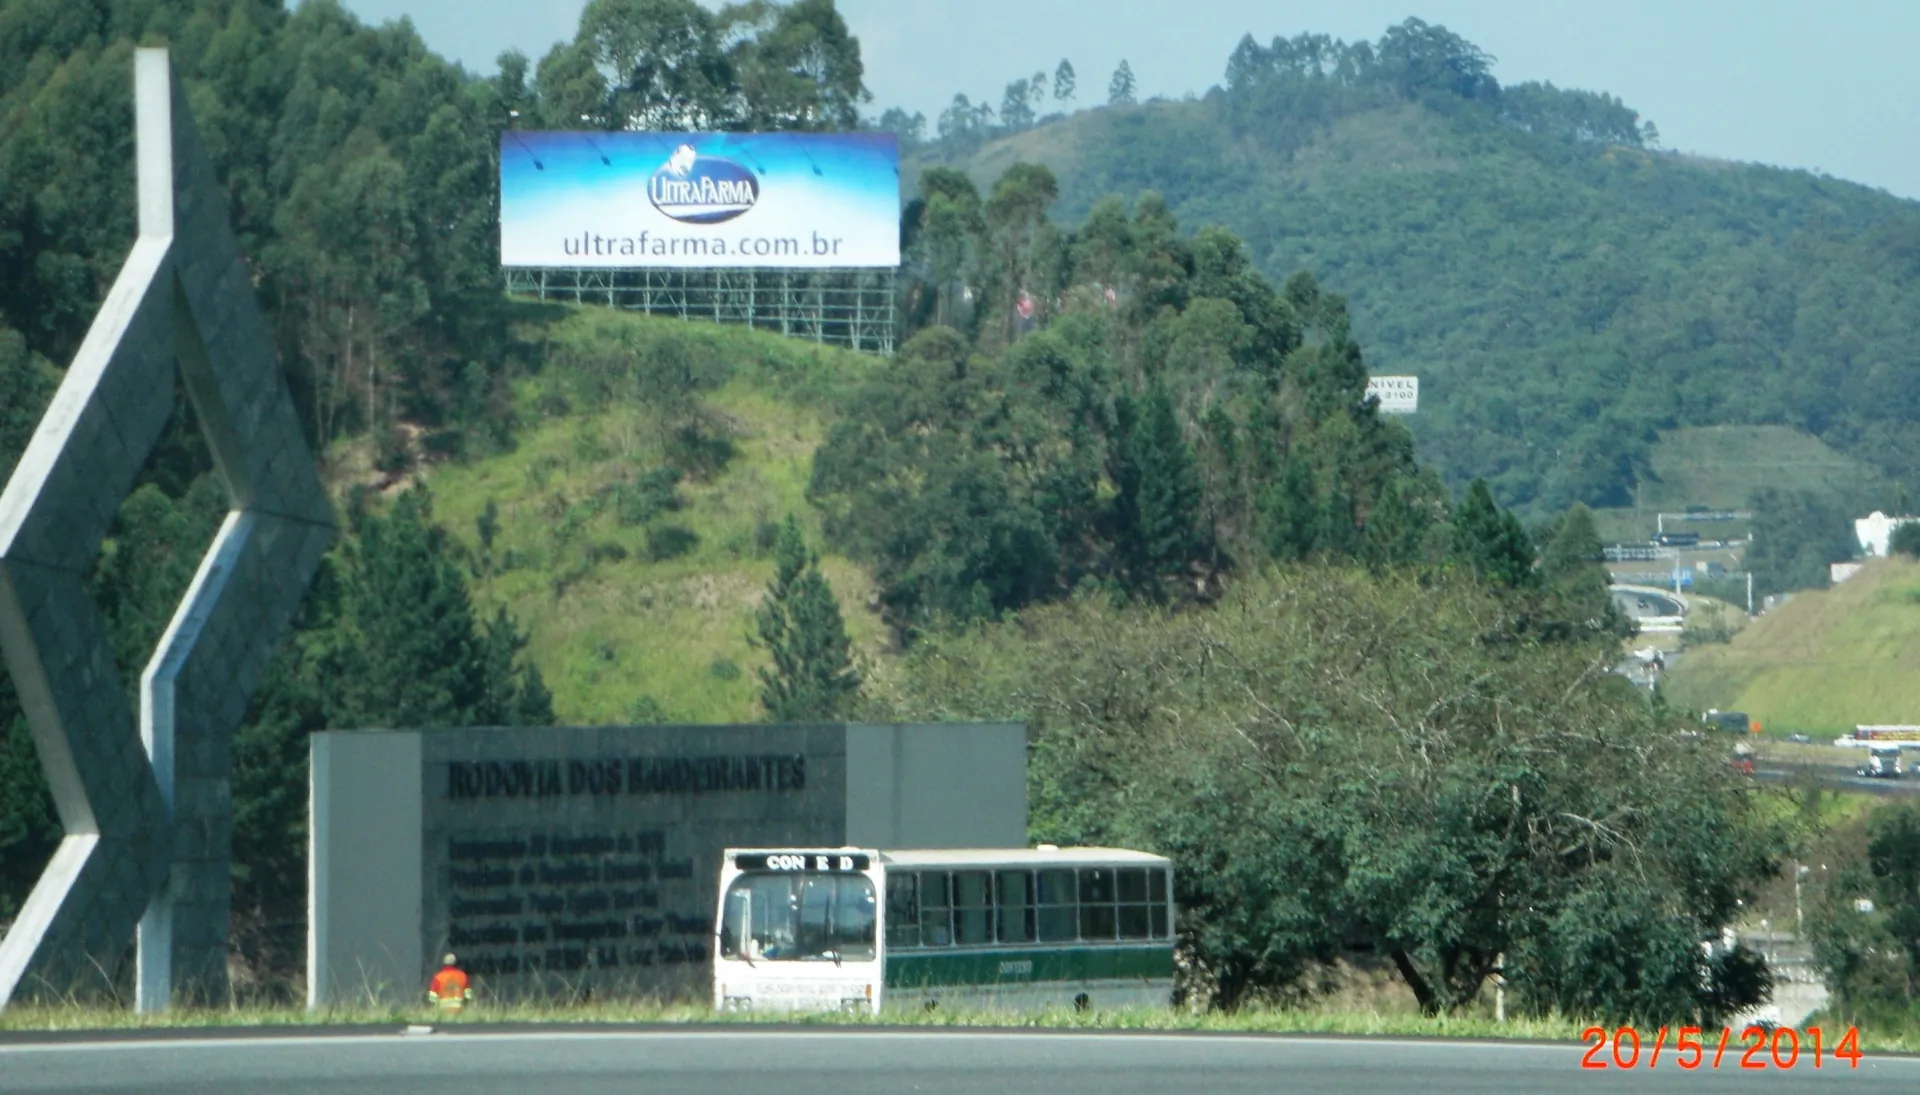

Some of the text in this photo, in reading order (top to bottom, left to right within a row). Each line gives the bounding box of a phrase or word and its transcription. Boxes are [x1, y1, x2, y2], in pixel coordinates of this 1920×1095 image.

[563, 230, 844, 256] ultrafarma.com.br
[448, 760, 561, 797] RODOVIA
[568, 757, 621, 794] DOS
[766, 855, 805, 870] CON
